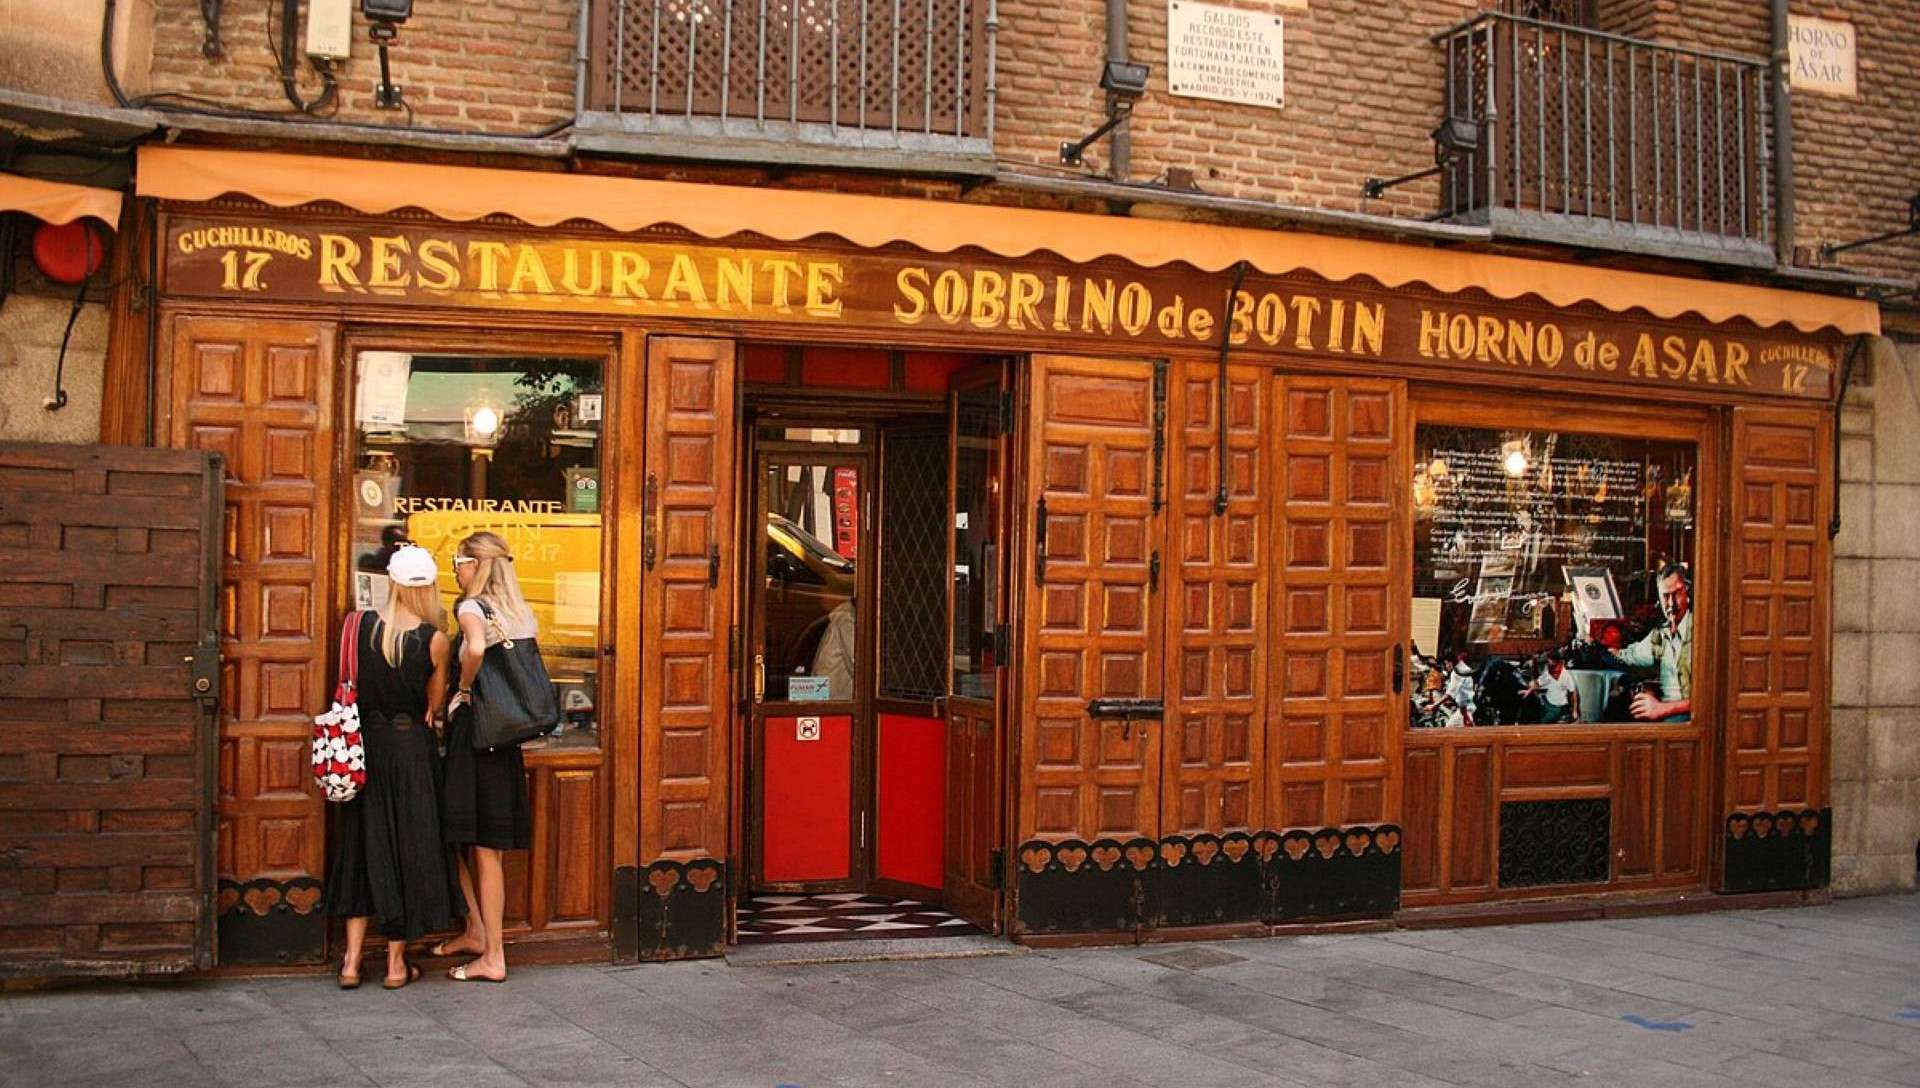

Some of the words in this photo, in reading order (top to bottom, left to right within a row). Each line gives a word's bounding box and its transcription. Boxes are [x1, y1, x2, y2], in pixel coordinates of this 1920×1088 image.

[1184, 34, 1254, 54] RESTAURANTE
[1257, 45, 1272, 56] EN
[1237, 29, 1264, 43] ESTE
[1789, 24, 1847, 49] HORNO
[1175, 46, 1229, 63] FORTUNATA
[1237, 55, 1278, 69] JACINTA
[1796, 55, 1842, 82] ASAR
[1235, 67, 1281, 82] COMERCIO
[1181, 82, 1219, 94] MADRID
[178, 226, 313, 261] CUCHILLEROS
[318, 234, 845, 319] RESTAURANTE
[893, 266, 1154, 337] SOBRINO
[1157, 294, 1215, 341] de
[1225, 289, 1387, 356] BOTIN
[1418, 309, 1565, 369] HORNO
[1573, 330, 1620, 371] de
[1628, 332, 1751, 386] ASAR
[394, 497, 563, 514] RESTAURANTE
